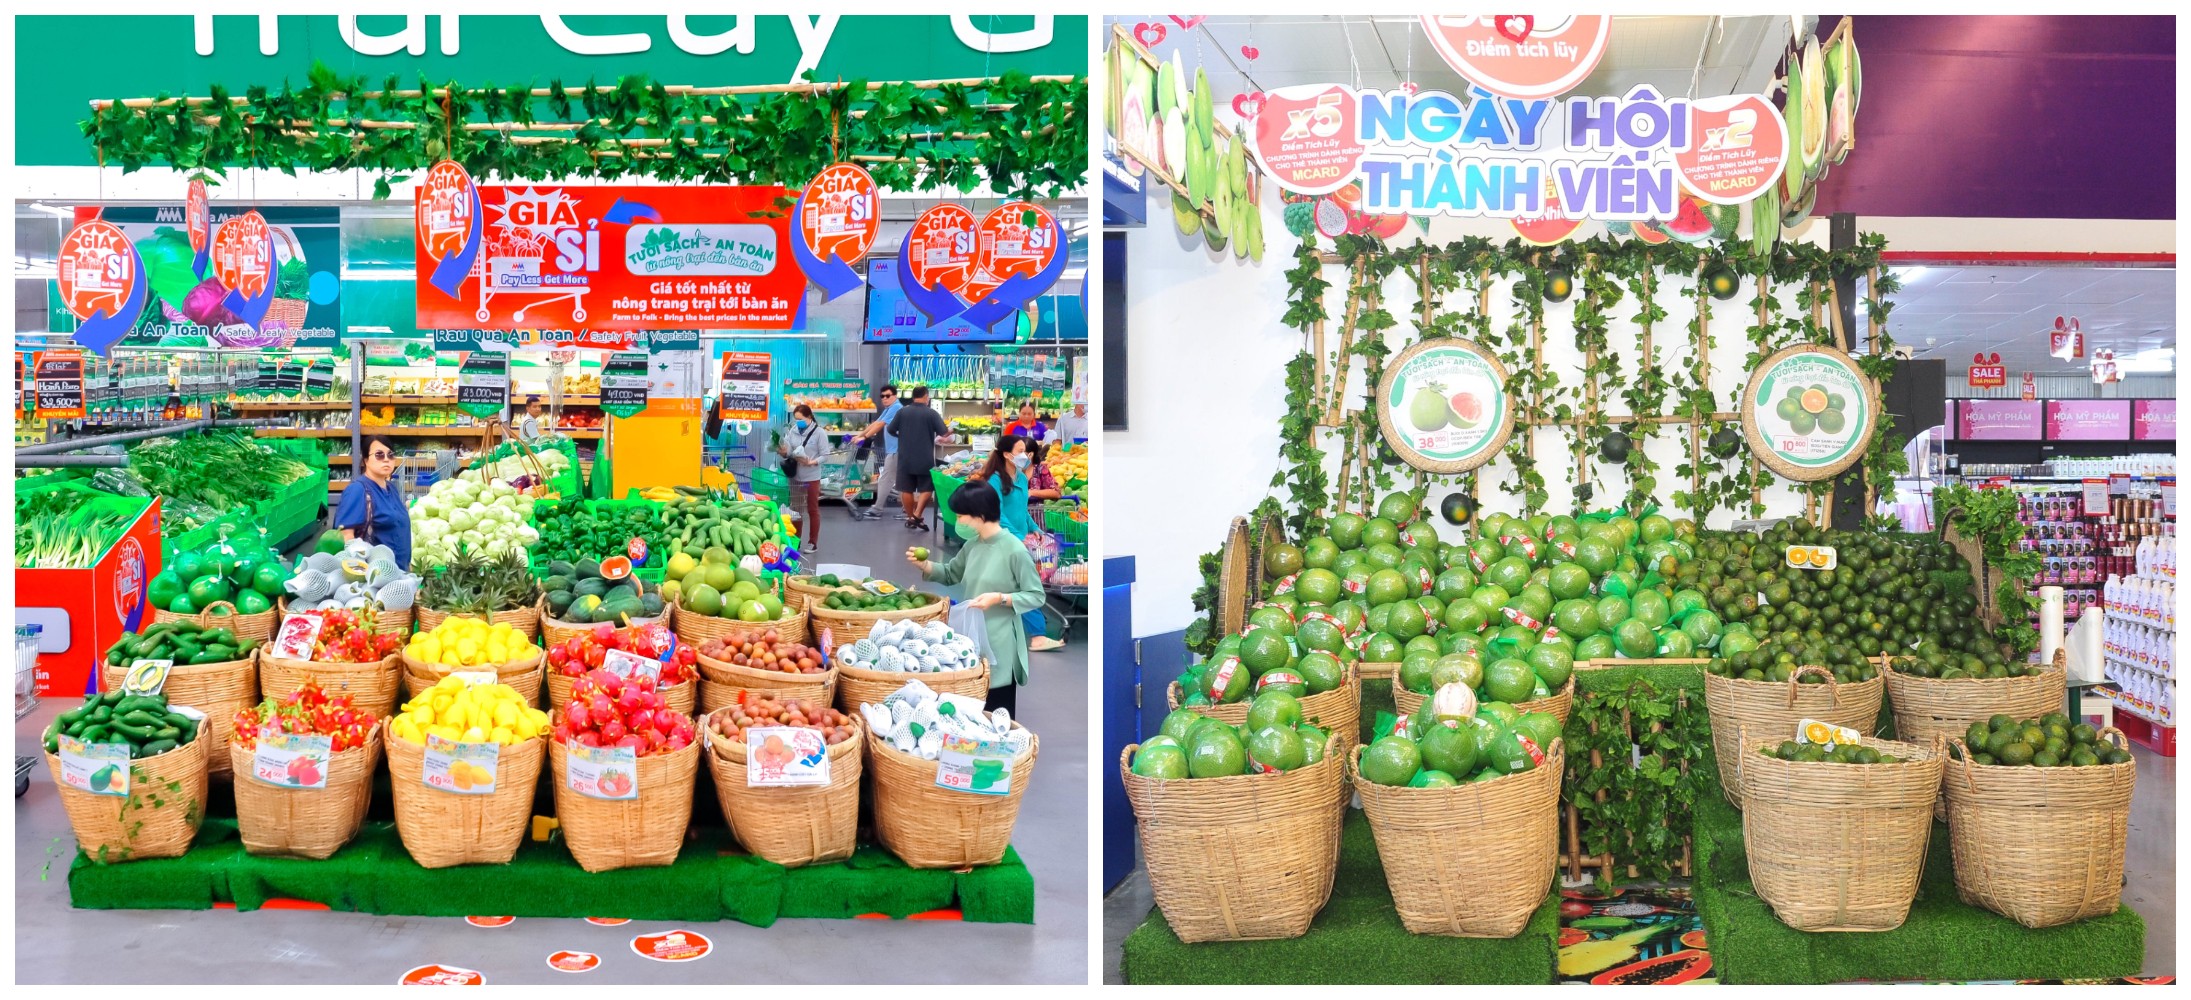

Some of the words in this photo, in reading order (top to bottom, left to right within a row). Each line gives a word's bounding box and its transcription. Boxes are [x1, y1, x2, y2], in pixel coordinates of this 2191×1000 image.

[1466, 37, 1510, 57] Điểm
[1554, 41, 1578, 62] lũy
[1280, 92, 1343, 141] x5
[1361, 88, 1549, 146] NGÀY
[1571, 89, 1686, 161] HỘI
[1700, 108, 1757, 152] x2
[1300, 151, 1320, 159] TRÌNH
[1308, 158, 1331, 167] THÀNH
[1332, 156, 1348, 164] VIÊN
[1717, 161, 1736, 169] TRÌNH
[1725, 168, 1747, 177] THÀNH
[1749, 166, 1764, 174] VIÊN
[1292, 166, 1341, 182] MCARD
[1361, 149, 1538, 211] THÀNH
[1558, 155, 1671, 213] VIÊN
[1710, 176, 1757, 192] MCARD
[555, 218, 600, 272] SỈ
[715, 238, 735, 251] AN
[739, 242, 774, 262] TOÀN
[501, 274, 519, 286] Pay
[521, 274, 542, 285] Less
[544, 274, 562, 285] Get
[563, 273, 588, 285] More
[650, 282, 672, 295] Giá
[676, 280, 698, 295] tốt
[700, 280, 732, 295] nhất
[735, 280, 752, 295] từ
[612, 297, 648, 313] nông
[651, 299, 688, 313] trang
[692, 297, 717, 312] trại
[719, 295, 739, 309] tới
[742, 297, 768, 309] bàn
[771, 297, 788, 309] ăn
[612, 313, 632, 321] Farm
[664, 313, 684, 322] Bring
[685, 313, 697, 321] the
[699, 313, 715, 321] best
[718, 313, 740, 322] prices
[742, 313, 747, 321] in
[748, 313, 760, 321] the
[762, 313, 788, 321] market
[143, 323, 166, 337] An
[174, 322, 209, 337] Toàn
[226, 327, 256, 338] Safety
[260, 327, 287, 338] Leafy
[290, 327, 335, 338] Vegetable
[435, 329, 467, 341] Rau
[508, 329, 531, 341] An
[590, 331, 622, 343] Safety
[624, 331, 648, 341] Fruit
[650, 331, 697, 342] Vegetable
[873, 328, 882, 337] 14
[948, 328, 960, 337] 32
[1823, 366, 1834, 374] AN
[1973, 368, 2001, 378] SALE
[1419, 437, 1435, 448] 38
[1782, 440, 1794, 451] 10
[259, 768, 272, 780] 24
[428, 774, 442, 786] 49
[944, 773, 959, 785] 59
[573, 779, 584, 792] 26
